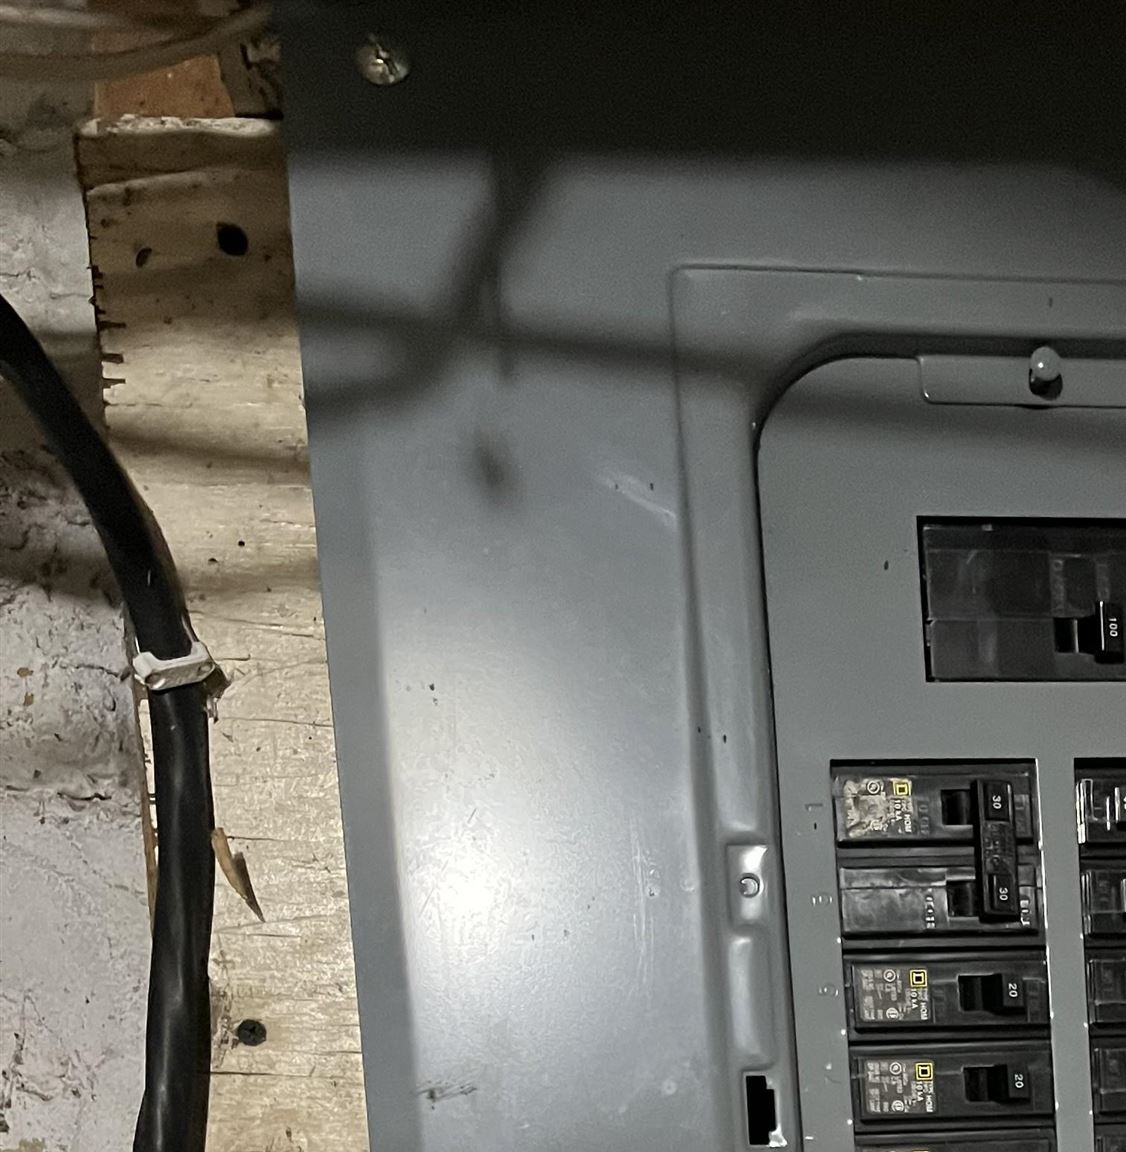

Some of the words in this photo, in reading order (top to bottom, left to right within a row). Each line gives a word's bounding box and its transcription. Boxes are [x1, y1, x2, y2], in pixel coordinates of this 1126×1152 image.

[1108, 617, 1118, 638] 100
[895, 800, 901, 809] 10
[992, 795, 1002, 810] 30
[999, 886, 1009, 901] 30
[911, 988, 917, 997] 10
[1007, 982, 1017, 998] 20
[916, 1081, 923, 1091] 10
[1014, 1073, 1024, 1089] 20
